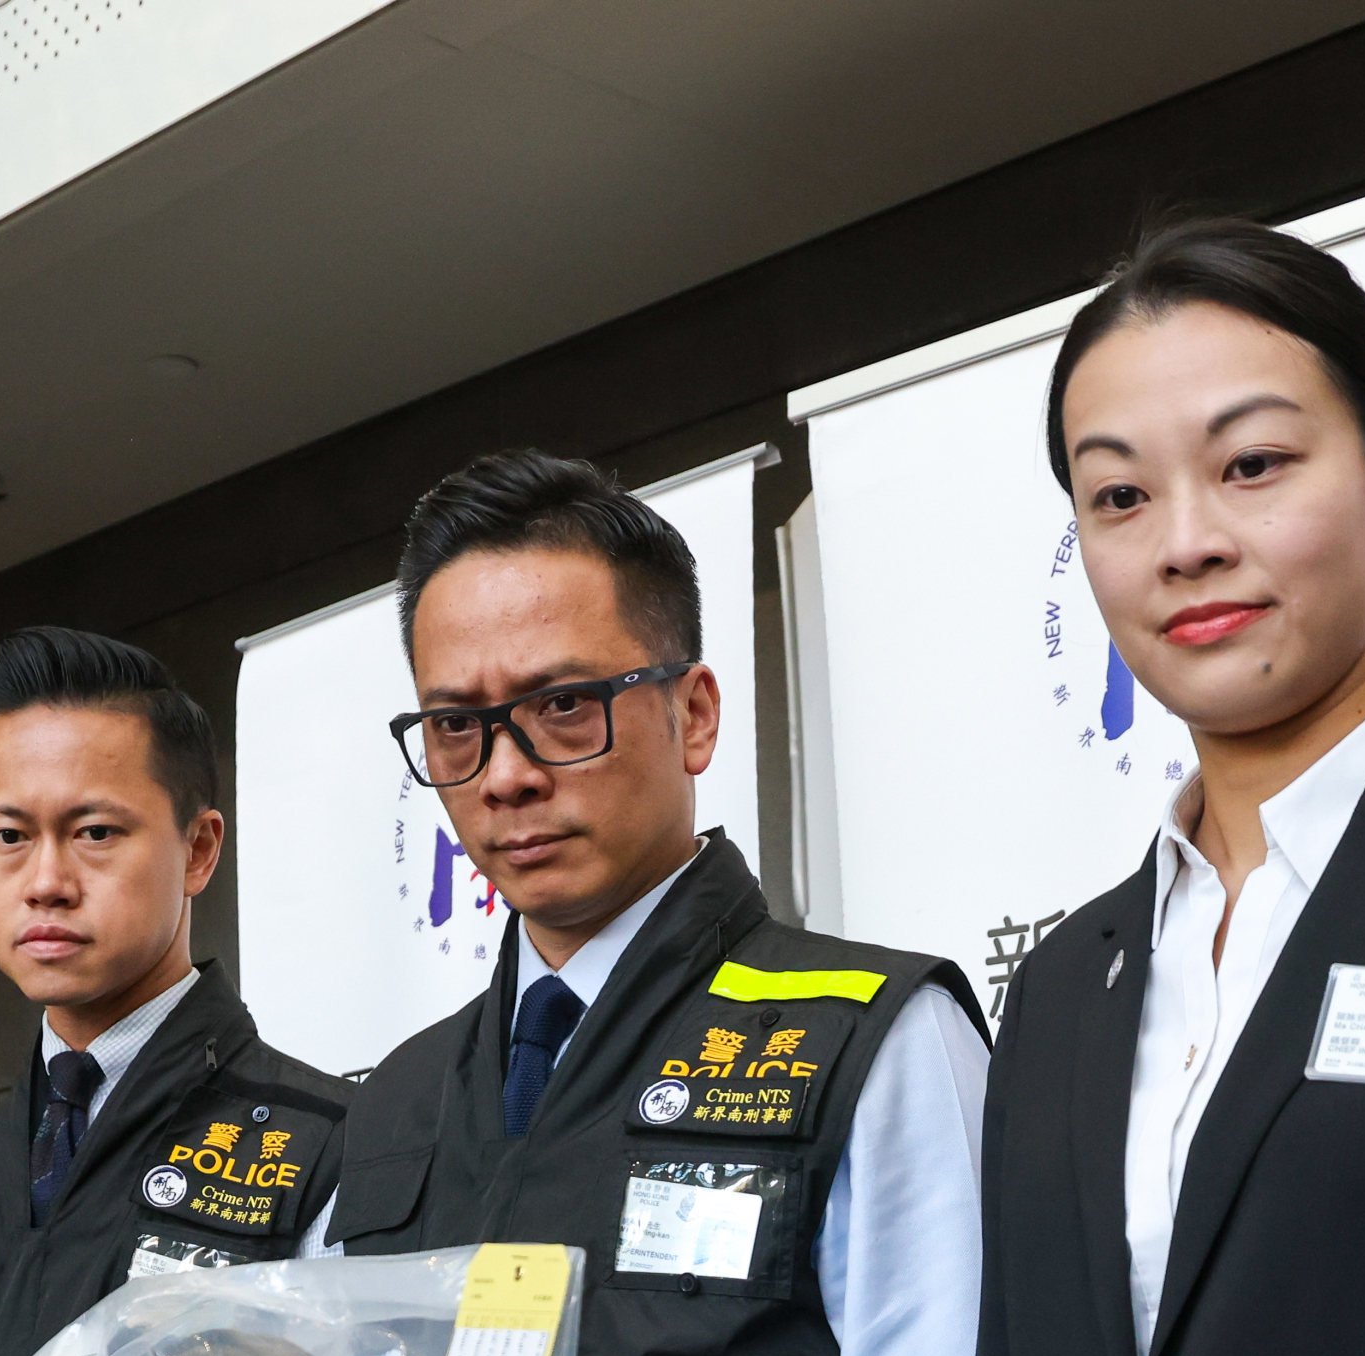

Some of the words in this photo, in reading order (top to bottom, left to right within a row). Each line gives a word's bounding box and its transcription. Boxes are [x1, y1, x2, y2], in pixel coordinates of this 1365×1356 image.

[1045, 600, 1063, 659] NEW
[394, 820, 406, 864] NEW
[699, 1026, 806, 1064] 警察
[693, 1105, 793, 1125] 新界南刑事部
[706, 1087, 753, 1105] Crime
[756, 1089, 791, 1105] NTS
[202, 1121, 292, 1160] 警察
[168, 1144, 301, 1188] POLICE
[190, 1197, 273, 1225] 新界南刑事部
[201, 1184, 244, 1207] Crime
[247, 1196, 273, 1210] NTS
